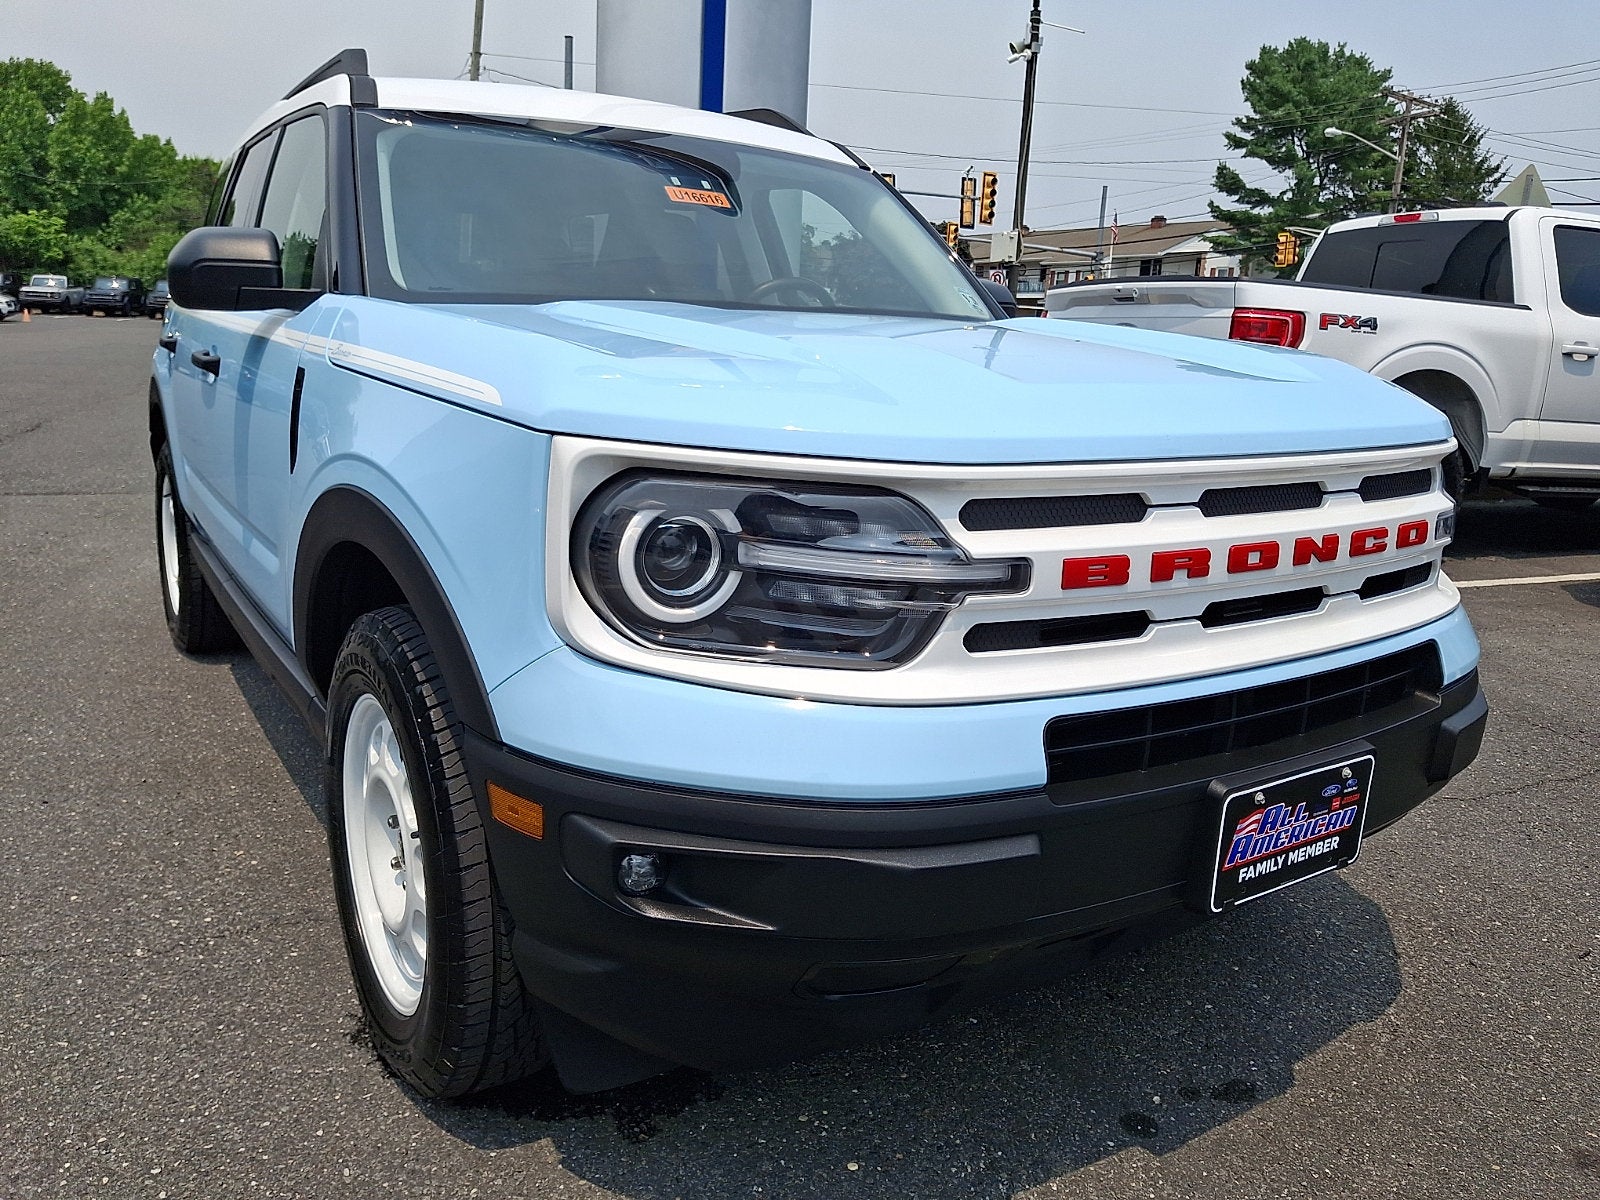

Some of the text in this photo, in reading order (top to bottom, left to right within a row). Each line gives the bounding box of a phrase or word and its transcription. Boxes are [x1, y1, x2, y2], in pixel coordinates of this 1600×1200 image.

[673, 189, 724, 205] U16616
[1319, 313, 1378, 330] FX4
[1061, 519, 1429, 590] BRONCO
[1238, 836, 1340, 883] FAMILY MEMBER
